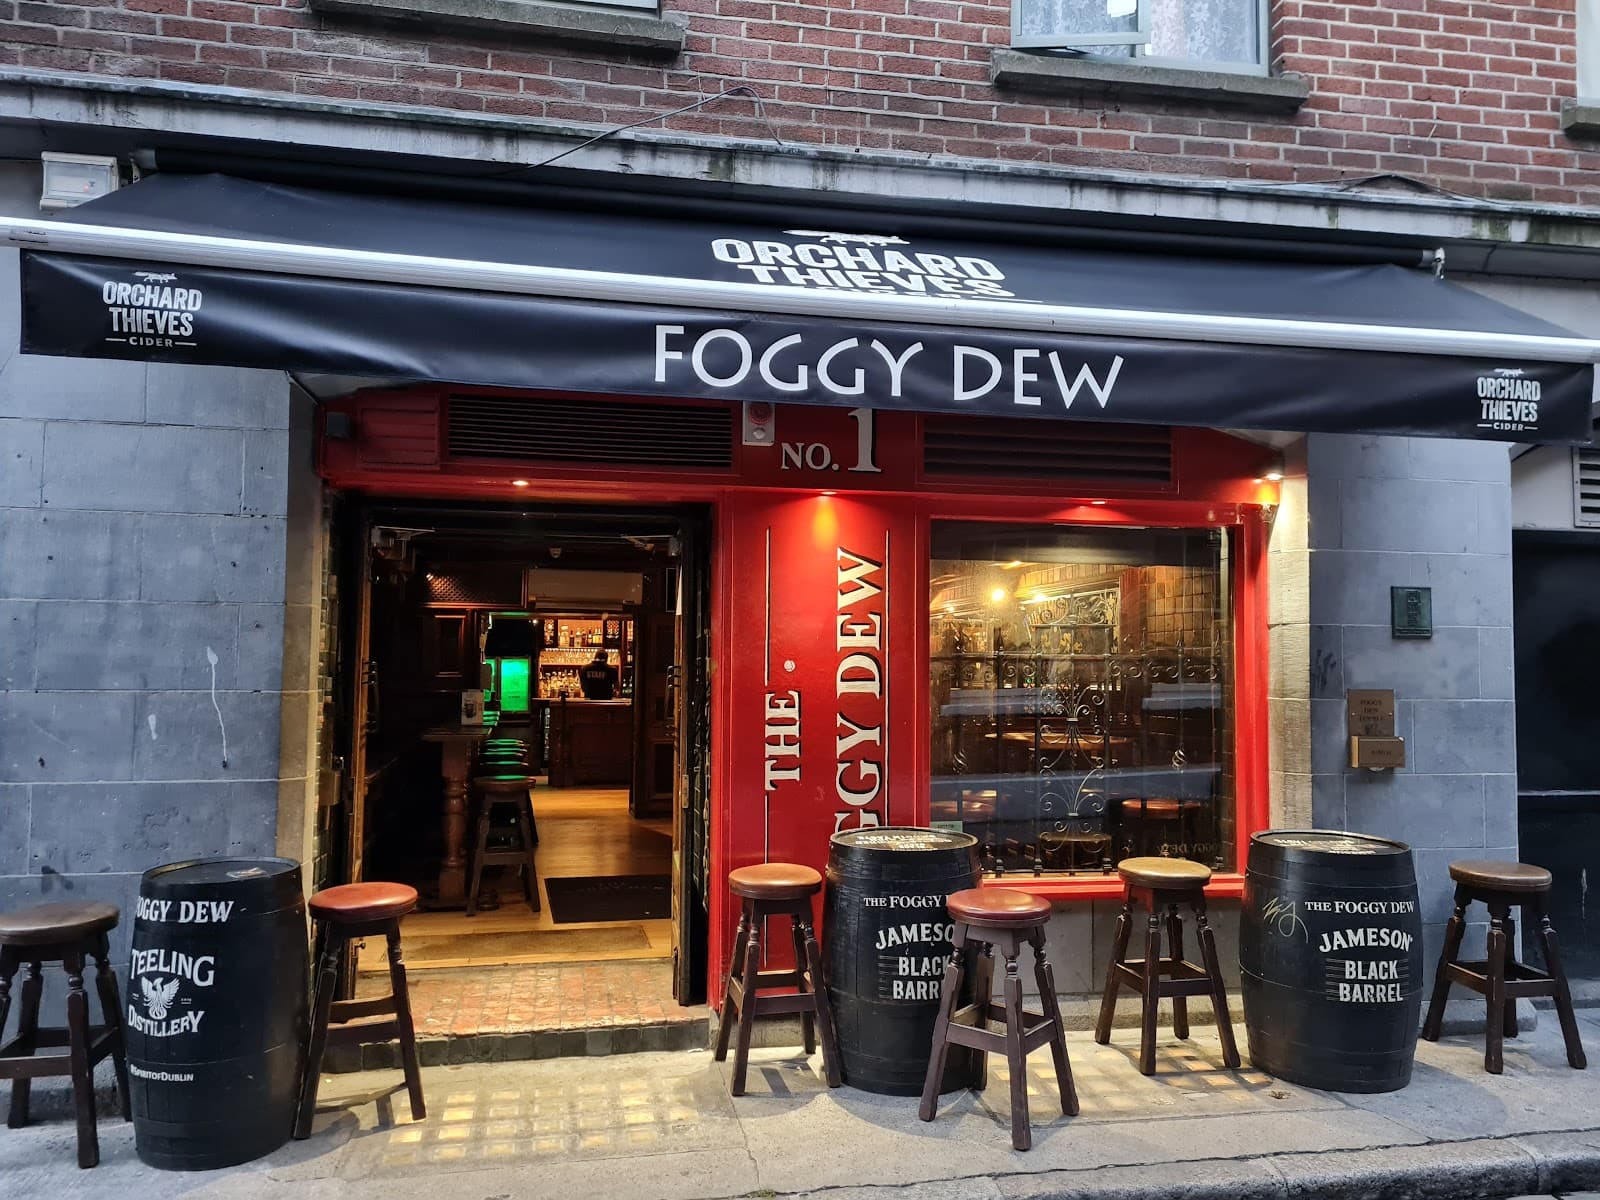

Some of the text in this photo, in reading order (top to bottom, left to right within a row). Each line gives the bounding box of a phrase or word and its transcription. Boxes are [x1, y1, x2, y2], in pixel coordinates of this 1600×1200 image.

[712, 239, 1006, 281] ORCHARD
[737, 264, 1015, 298] THIEVES
[102, 281, 203, 311] ORCHARD
[108, 307, 193, 336] THIEVES
[128, 336, 174, 347] CIDER
[654, 325, 1124, 409] FOGGY DEW
[1477, 377, 1541, 401] ORCHARD
[1481, 400, 1538, 422] THIEVES
[780, 407, 882, 473] NO. 1
[1493, 422, 1525, 432] CIDER
[836, 547, 883, 700] DEW
[765, 690, 801, 791] THE
[135, 896, 235, 923] OGGY DEW
[864, 897, 888, 907] THE
[889, 895, 942, 908] FOGGY
[1304, 900, 1415, 914] THE FOGGY DEW
[875, 923, 956, 950] JAMESO
[1319, 928, 1410, 953] JAMESON
[130, 948, 215, 987] TEELING
[1345, 960, 1399, 980] BLACK
[893, 980, 940, 1000] BARR
[1339, 983, 1404, 1003] BARREL
[127, 1004, 204, 1038] DISTILLERY
